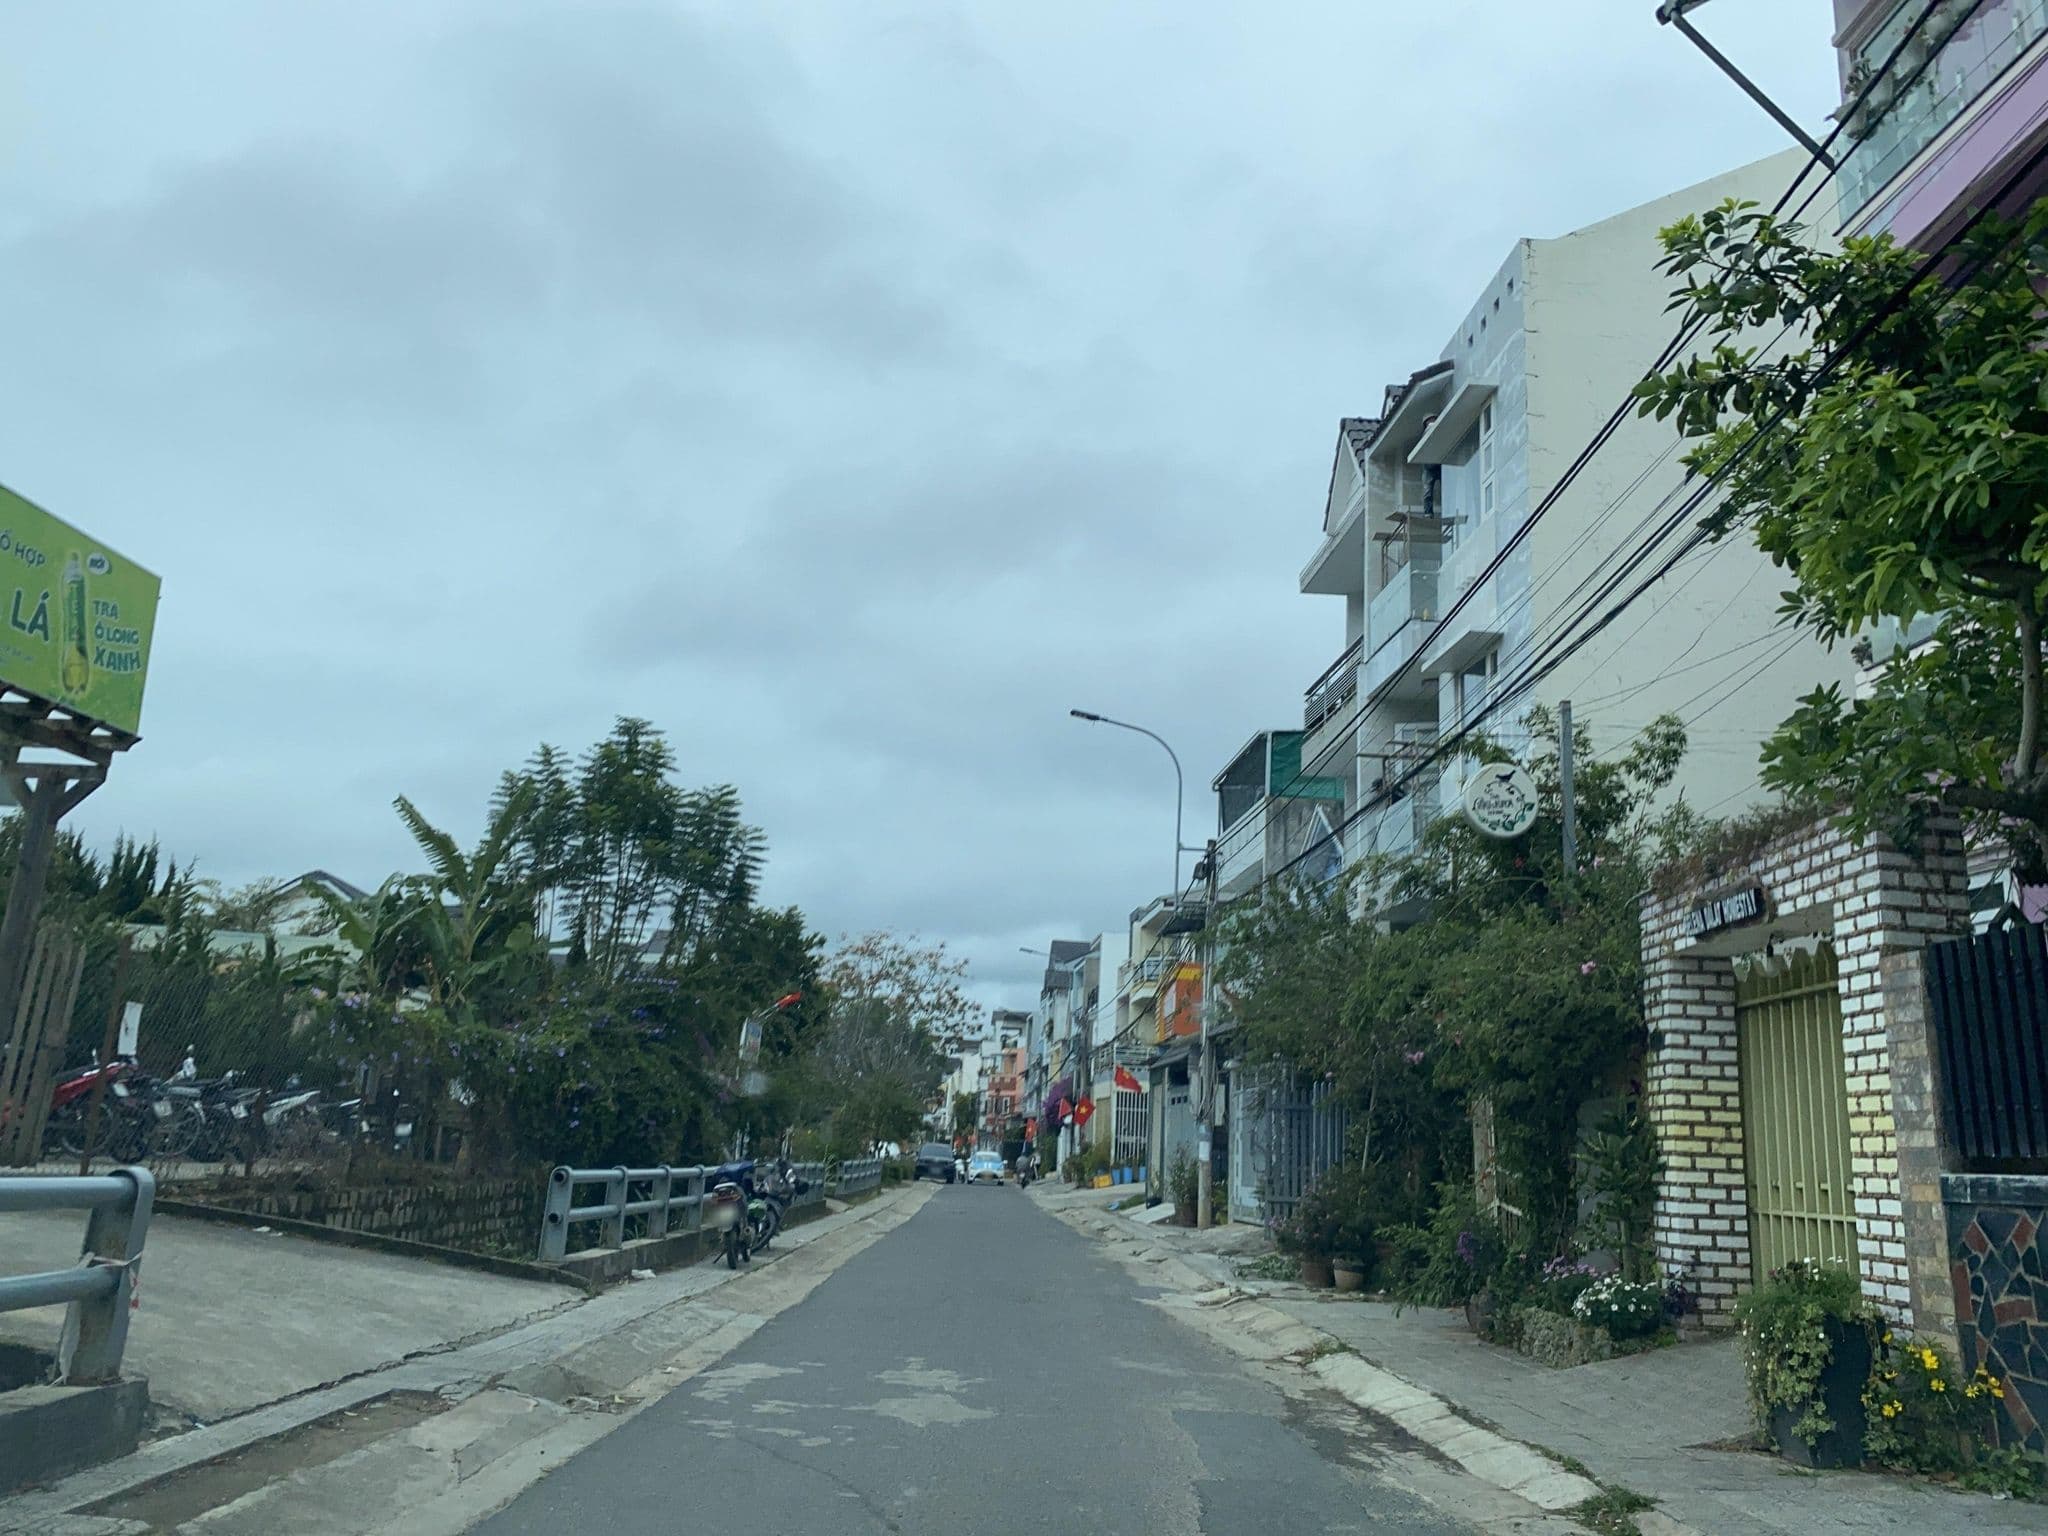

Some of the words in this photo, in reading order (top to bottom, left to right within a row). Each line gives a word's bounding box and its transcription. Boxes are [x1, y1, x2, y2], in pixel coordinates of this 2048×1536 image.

[11, 590, 49, 642] LÁ
[106, 628, 140, 645] LONG
[93, 646, 141, 672] XANH
